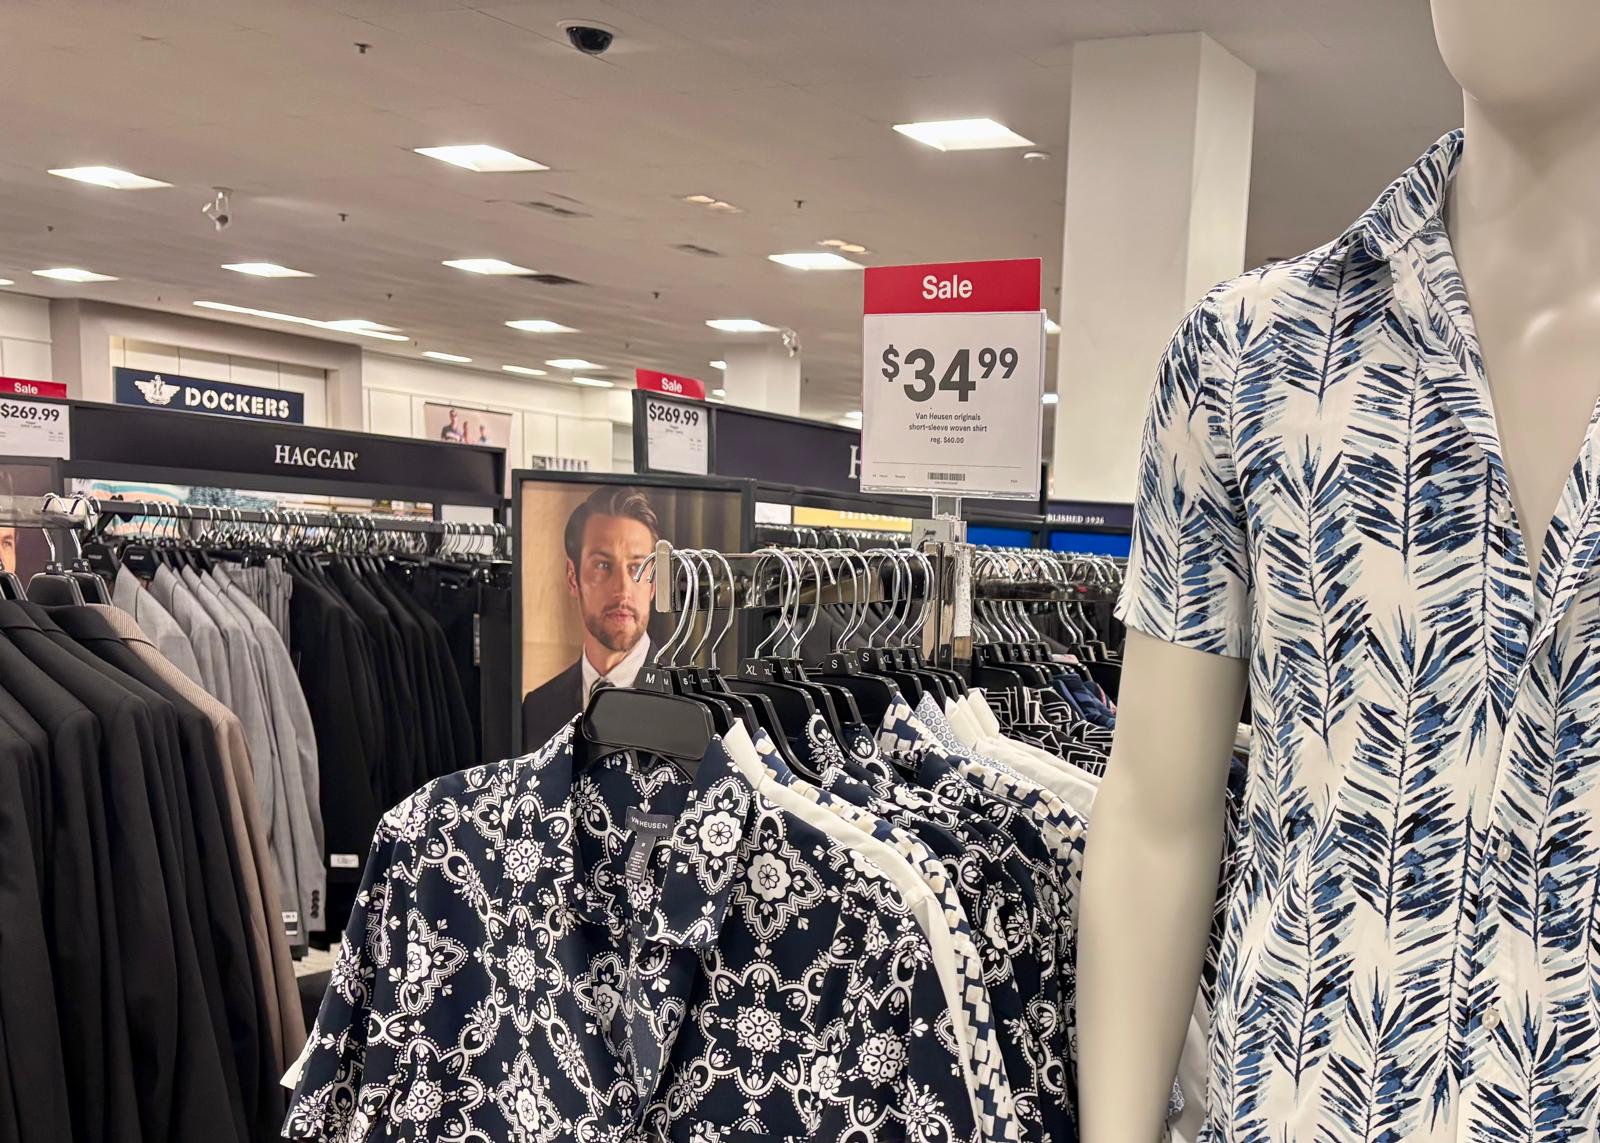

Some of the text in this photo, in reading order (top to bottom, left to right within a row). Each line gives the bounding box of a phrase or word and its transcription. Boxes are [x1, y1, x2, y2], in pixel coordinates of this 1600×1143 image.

[922, 275, 973, 299] Sale
[14, 382, 38, 395] Sale
[661, 377, 683, 393] Sale
[185, 386, 290, 419] DOCKERS
[0, 403, 60, 422] $269.99
[649, 402, 699, 426] $269.99
[915, 412, 981, 422] Van Heusen originals
[909, 424, 949, 432] short-sleeve
[943, 436, 965, 444] $60.00
[862, 652, 870, 662] S
[745, 664, 757, 676] XL
[831, 659, 838, 669] S
[645, 673, 656, 685] M
[639, 820, 669, 830] HEUSEN
